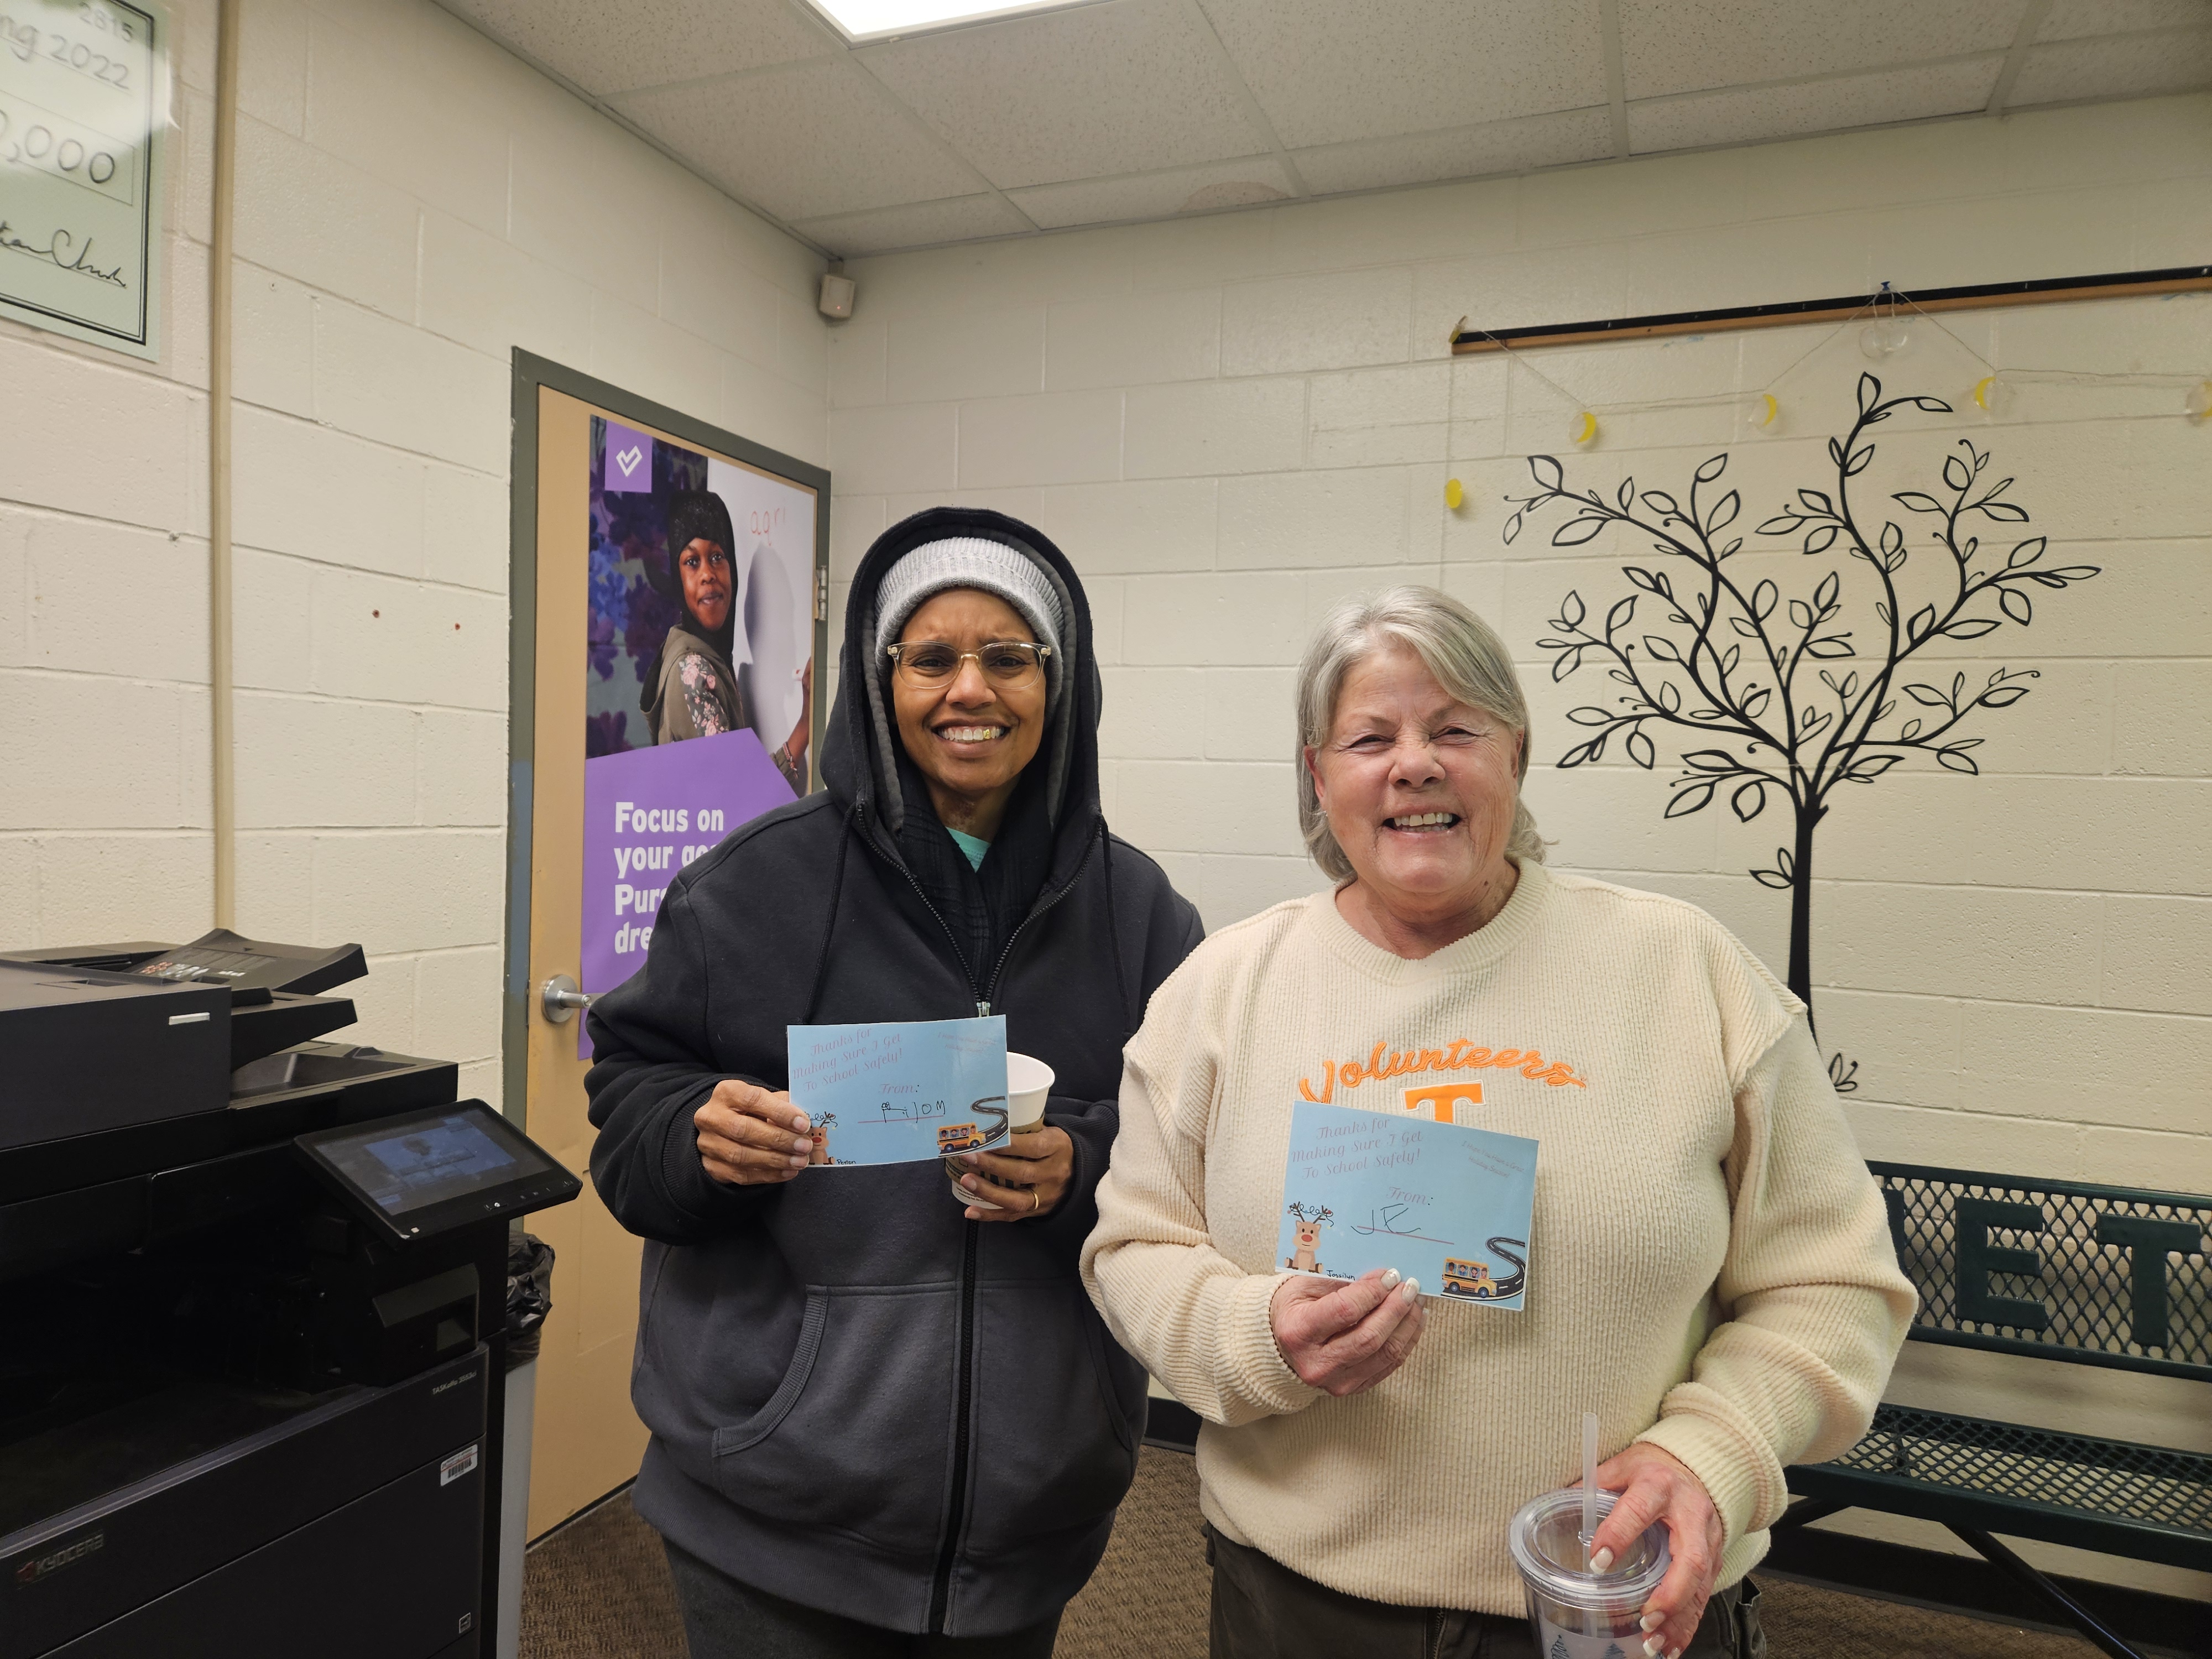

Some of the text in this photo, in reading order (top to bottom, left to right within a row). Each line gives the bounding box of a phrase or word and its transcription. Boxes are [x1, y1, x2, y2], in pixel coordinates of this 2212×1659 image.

[50, 34, 129, 90] 2022
[615, 802, 724, 833] Focus on
[614, 846, 674, 879] your
[793, 1034, 901, 1079] Making Sure I Get
[811, 1029, 872, 1056] Thanks for
[804, 1048, 902, 1092] To School Safely!
[1300, 1038, 1586, 1104] Volunteers
[1400, 1080, 1485, 1124] T
[1316, 1118, 1390, 1140] Thanks for
[1291, 1131, 1423, 1162] Making Sure I Get
[1302, 1148, 1420, 1180] To School Safely!
